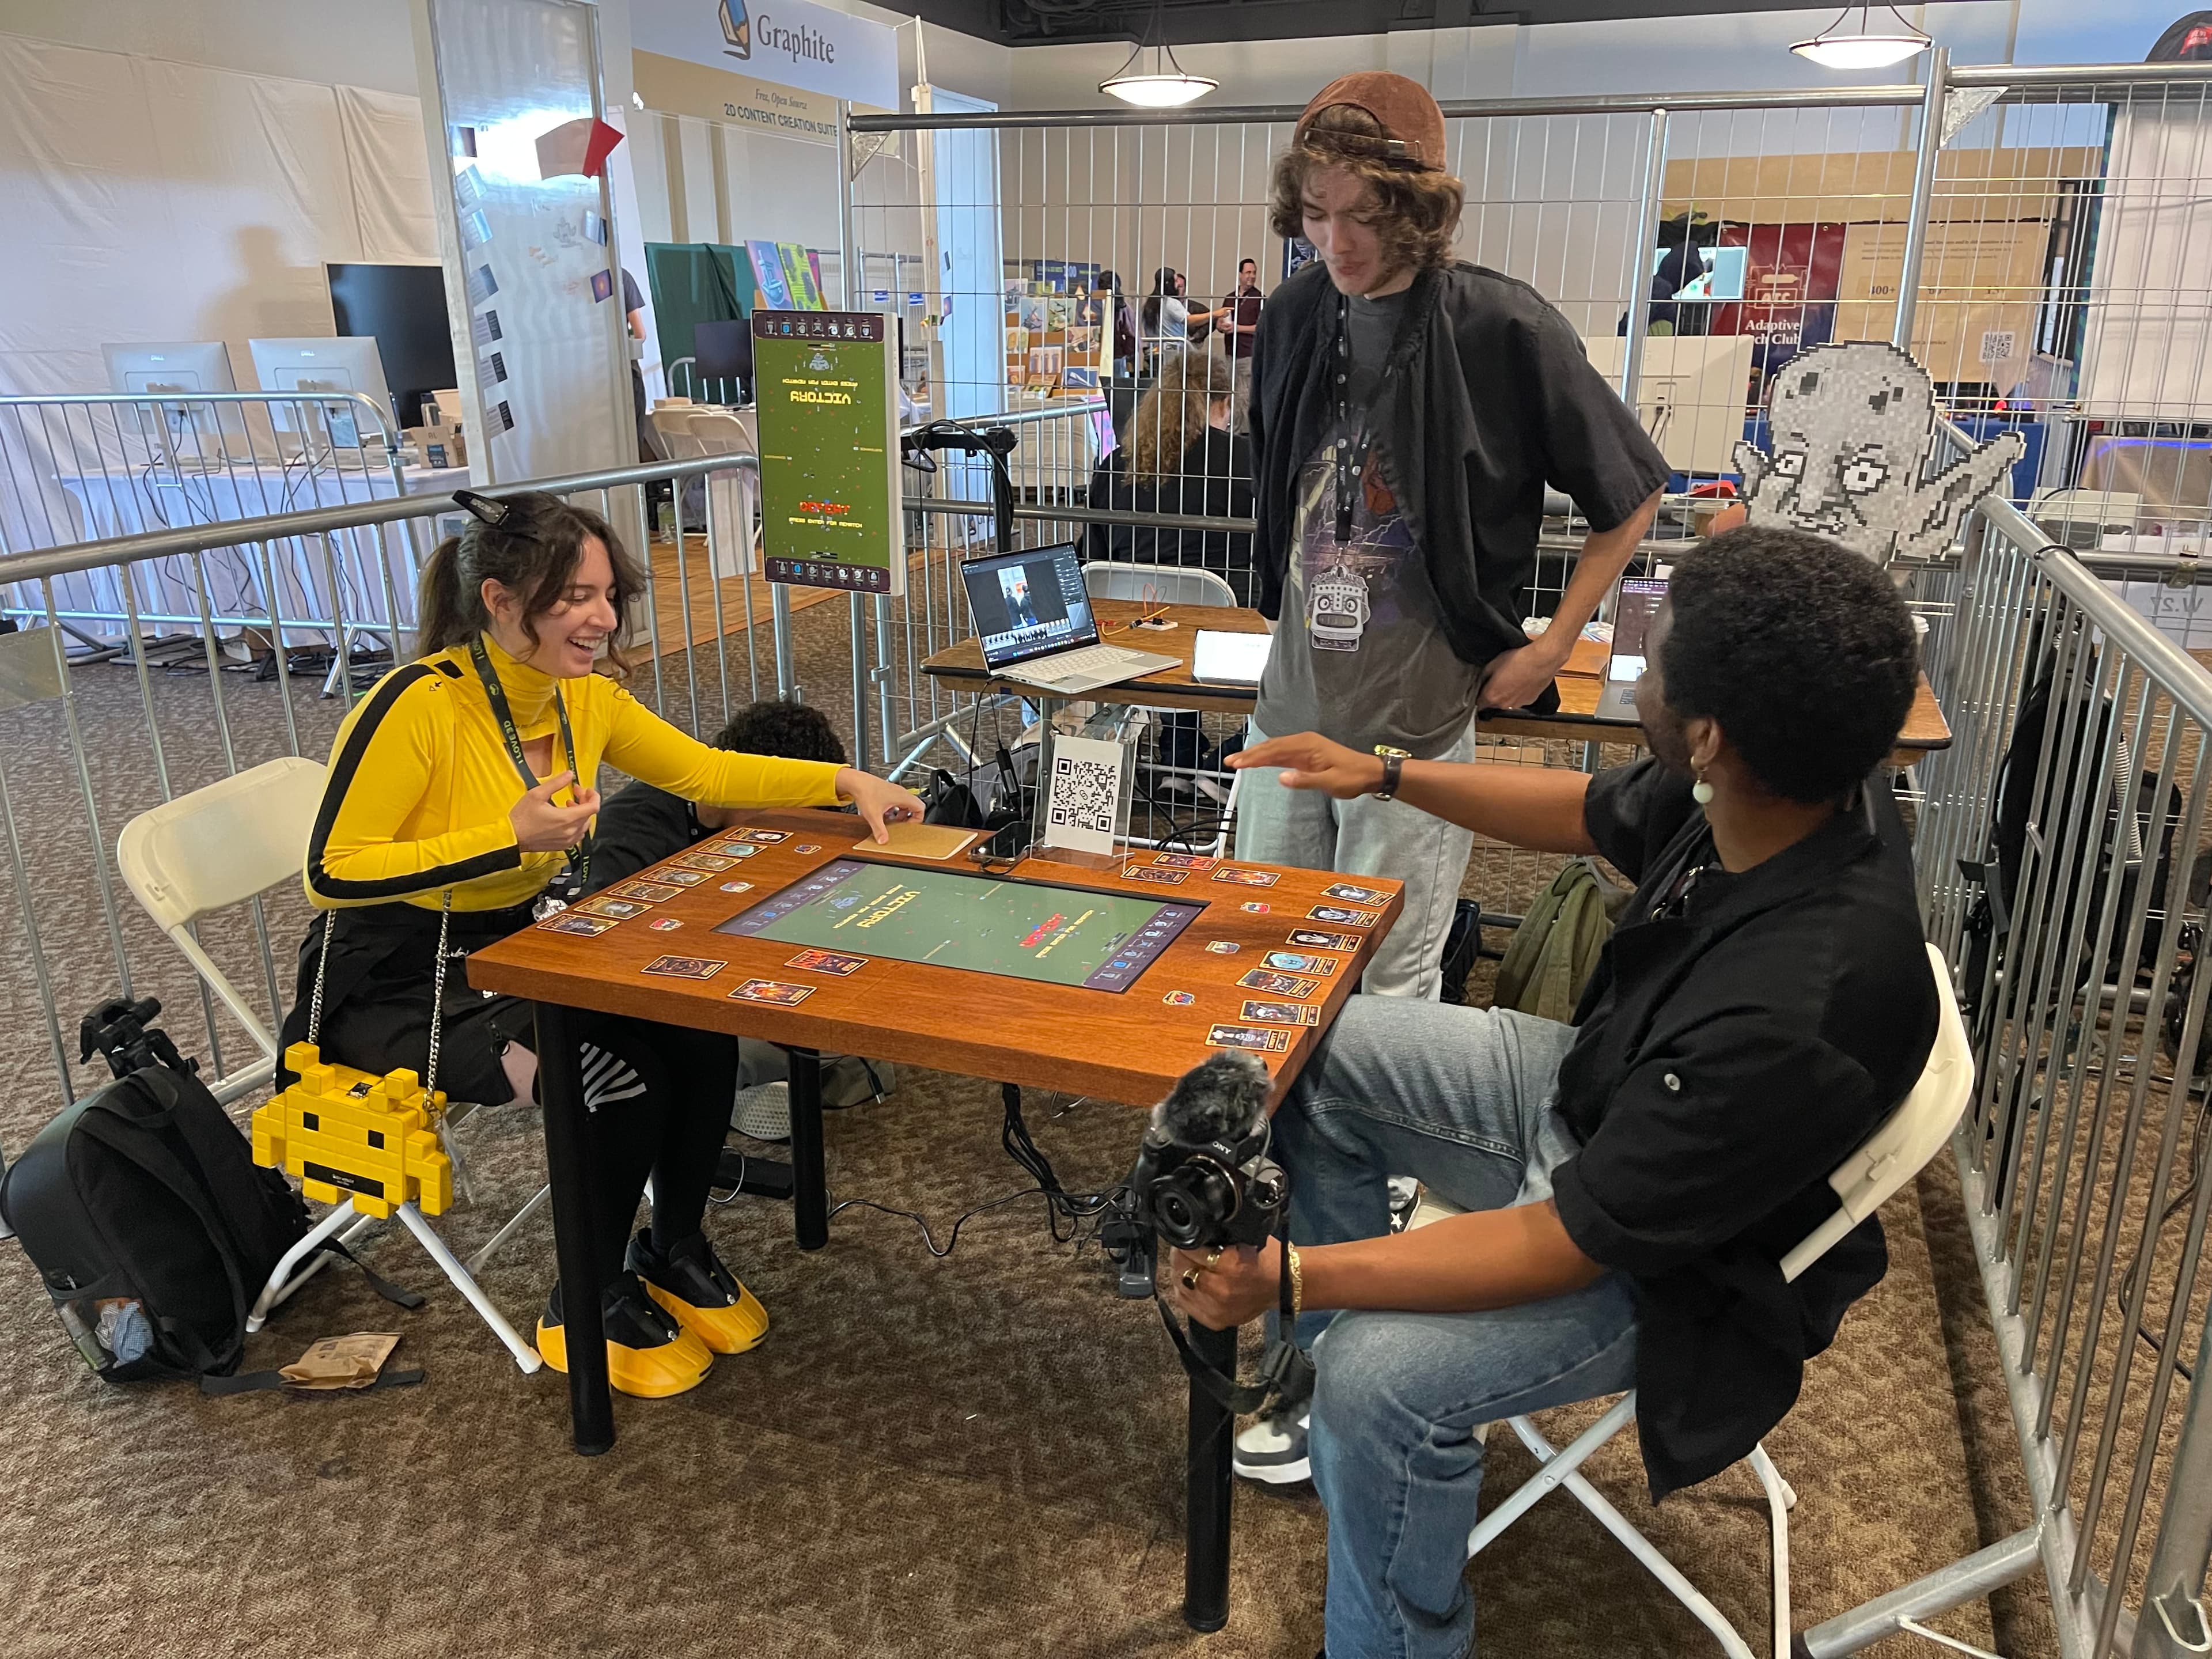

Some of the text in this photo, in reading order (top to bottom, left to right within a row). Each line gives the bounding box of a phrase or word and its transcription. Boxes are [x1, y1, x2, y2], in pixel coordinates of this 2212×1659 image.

[757, 14, 834, 63] Graphite
[755, 88, 808, 109] Free, Open Source
[724, 103, 838, 137] 2D CONTENT CREATION SUITE
[1745, 319, 1800, 334] Adaptive
[1755, 334, 1801, 345] ch Club
[790, 391, 852, 405] VICTORY
[503, 720, 514, 734] 3D
[509, 734, 522, 760] LOVE
[856, 891, 922, 928] VICTORY
[1212, 1141, 1232, 1154] ONY
